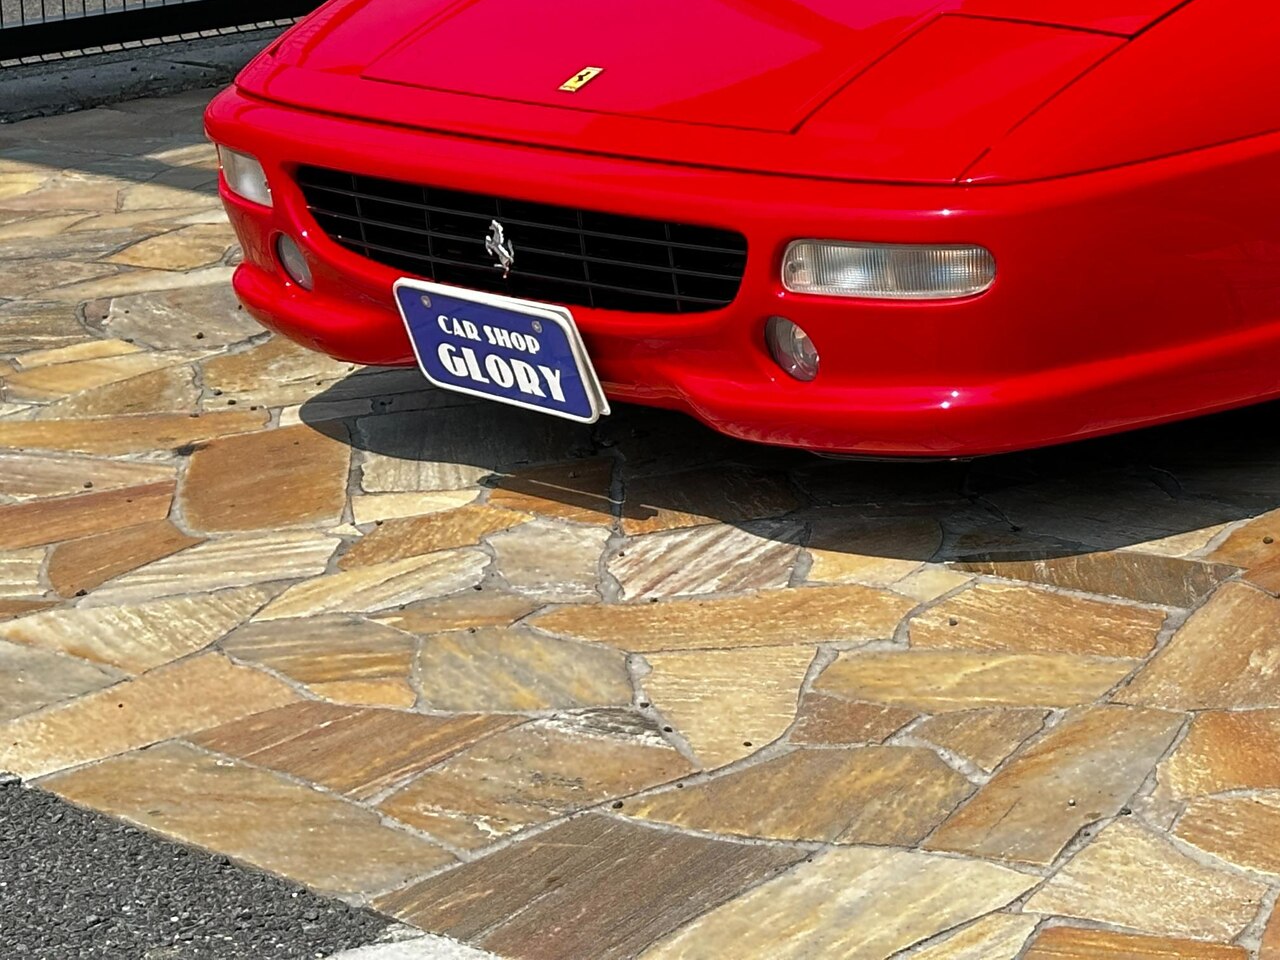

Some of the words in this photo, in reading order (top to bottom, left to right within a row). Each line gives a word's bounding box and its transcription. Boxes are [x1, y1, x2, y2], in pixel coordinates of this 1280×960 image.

[437, 314, 482, 342] CAR
[483, 324, 541, 355] SHOP
[437, 342, 566, 403] GLORY
